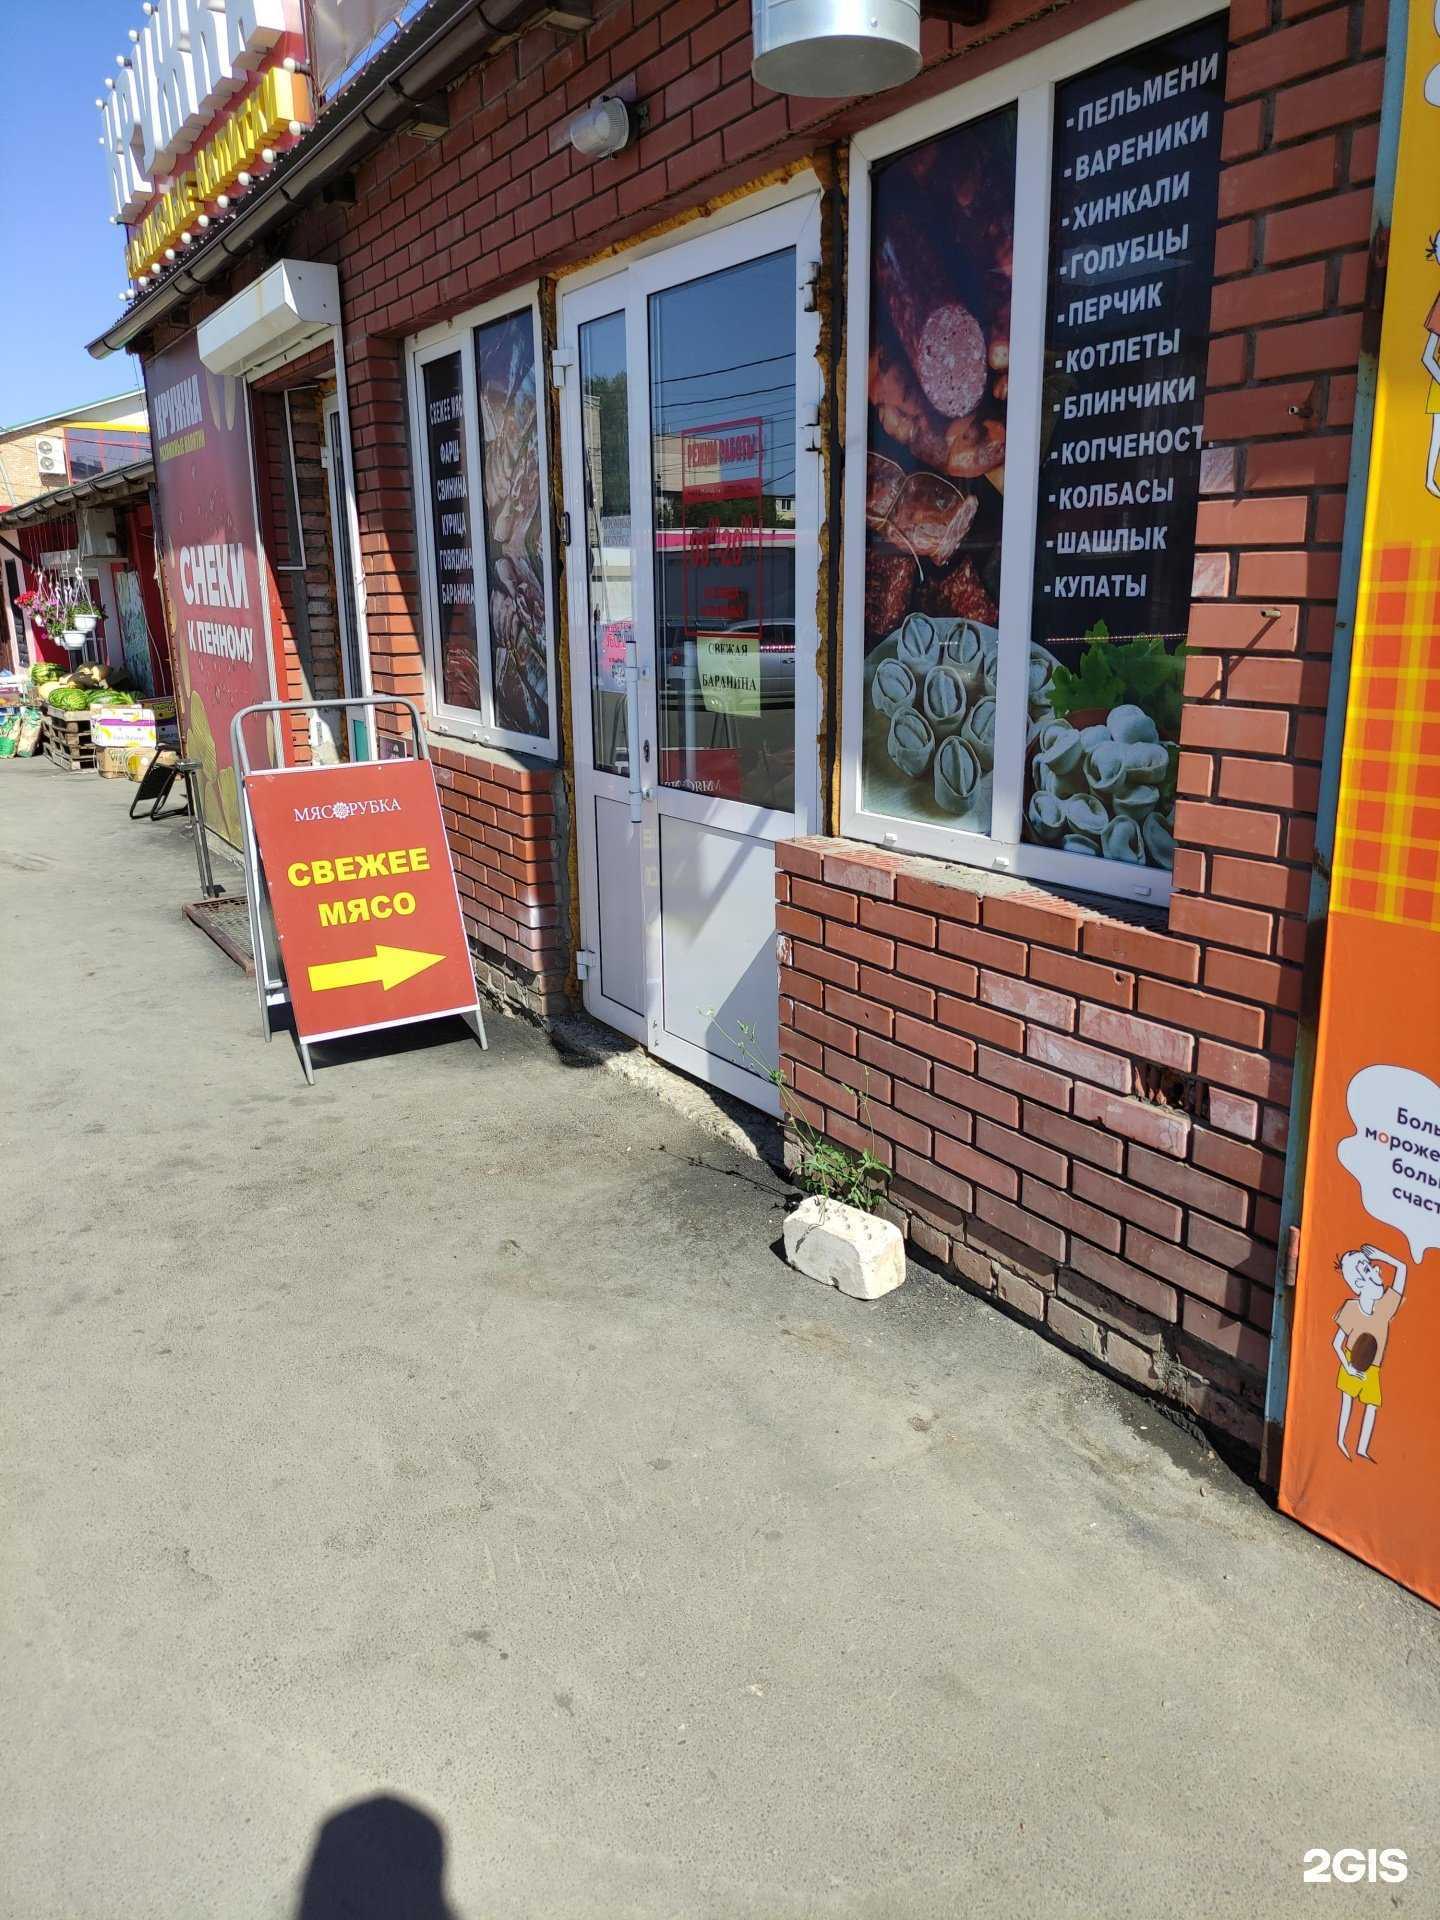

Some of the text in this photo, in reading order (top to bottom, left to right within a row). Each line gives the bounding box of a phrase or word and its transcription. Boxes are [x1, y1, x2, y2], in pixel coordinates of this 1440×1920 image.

[1077, 52, 1219, 131] ПЕЛЬМЕНИ
[1075, 111, 1209, 182] ВАРЕНИКИ
[1072, 171, 1190, 231] ХИНКАЛИ
[1070, 223, 1189, 279] ГОЛУБЦЫ
[1068, 282, 1164, 327] ПЕРЧИК
[1065, 328, 1181, 374] КОТЛЕТЫ
[154, 374, 203, 440] КРУЖКА
[430, 398, 451, 426] СВЕЖЕЕ
[1063, 375, 1196, 420] БЛИНЧИКИ
[440, 439, 460, 464] ФАРШ
[1061, 424, 1214, 465] КОПЧЕНОСТ
[437, 475, 468, 500] СВИНИНА
[1059, 478, 1174, 510] КОЛБАСЫ
[441, 512, 467, 538] КУРИЦА
[1057, 526, 1168, 554] ШАШЛЫК
[179, 543, 250, 609] СНЕКИ
[440, 547, 473, 574] ГОВЯДИНА
[442, 583, 475, 605] БАРАНИНА
[1054, 575, 1147, 599] КУПАТЫ
[187, 620, 254, 664] К ПЕННОМУ
[708, 642, 749, 657] СВЕЖАЯ
[702, 673, 757, 691] БАРАНИНА
[287, 847, 431, 887] СВЕЖЕЕ
[318, 892, 416, 927] МЯСО
[1365, 1127, 1440, 1162] мороже
